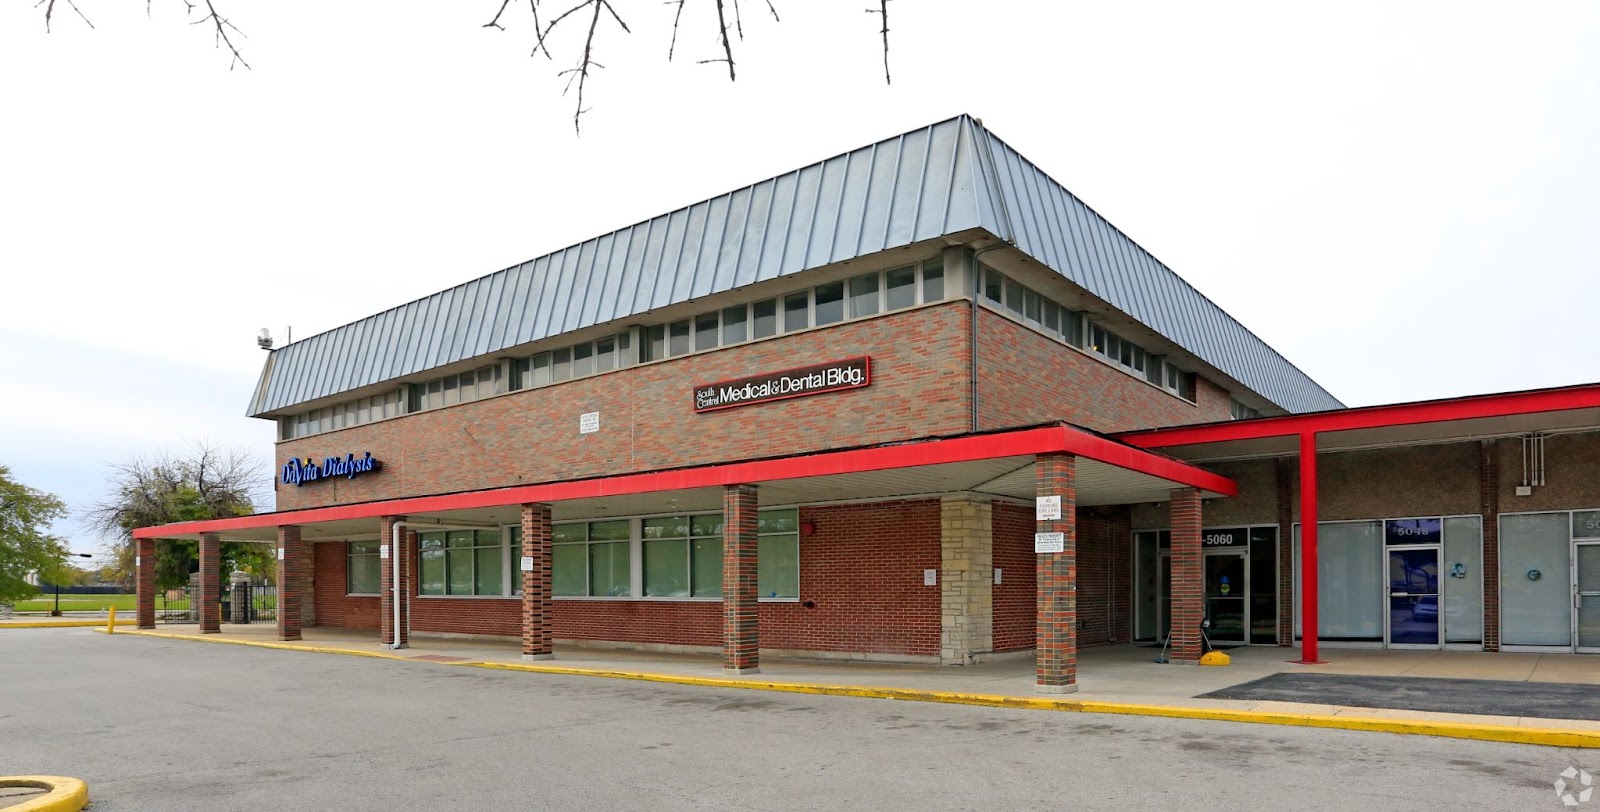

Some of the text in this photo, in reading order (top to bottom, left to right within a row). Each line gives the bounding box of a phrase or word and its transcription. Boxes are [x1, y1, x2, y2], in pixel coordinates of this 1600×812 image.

[720, 381, 771, 403] Medical
[780, 370, 826, 394] Dental
[828, 366, 865, 385] Bldg.
[696, 387, 715, 400] South
[696, 396, 720, 409] Central
[282, 452, 375, 486] DaVita Dialysis
[1397, 527, 1429, 536] 5048
